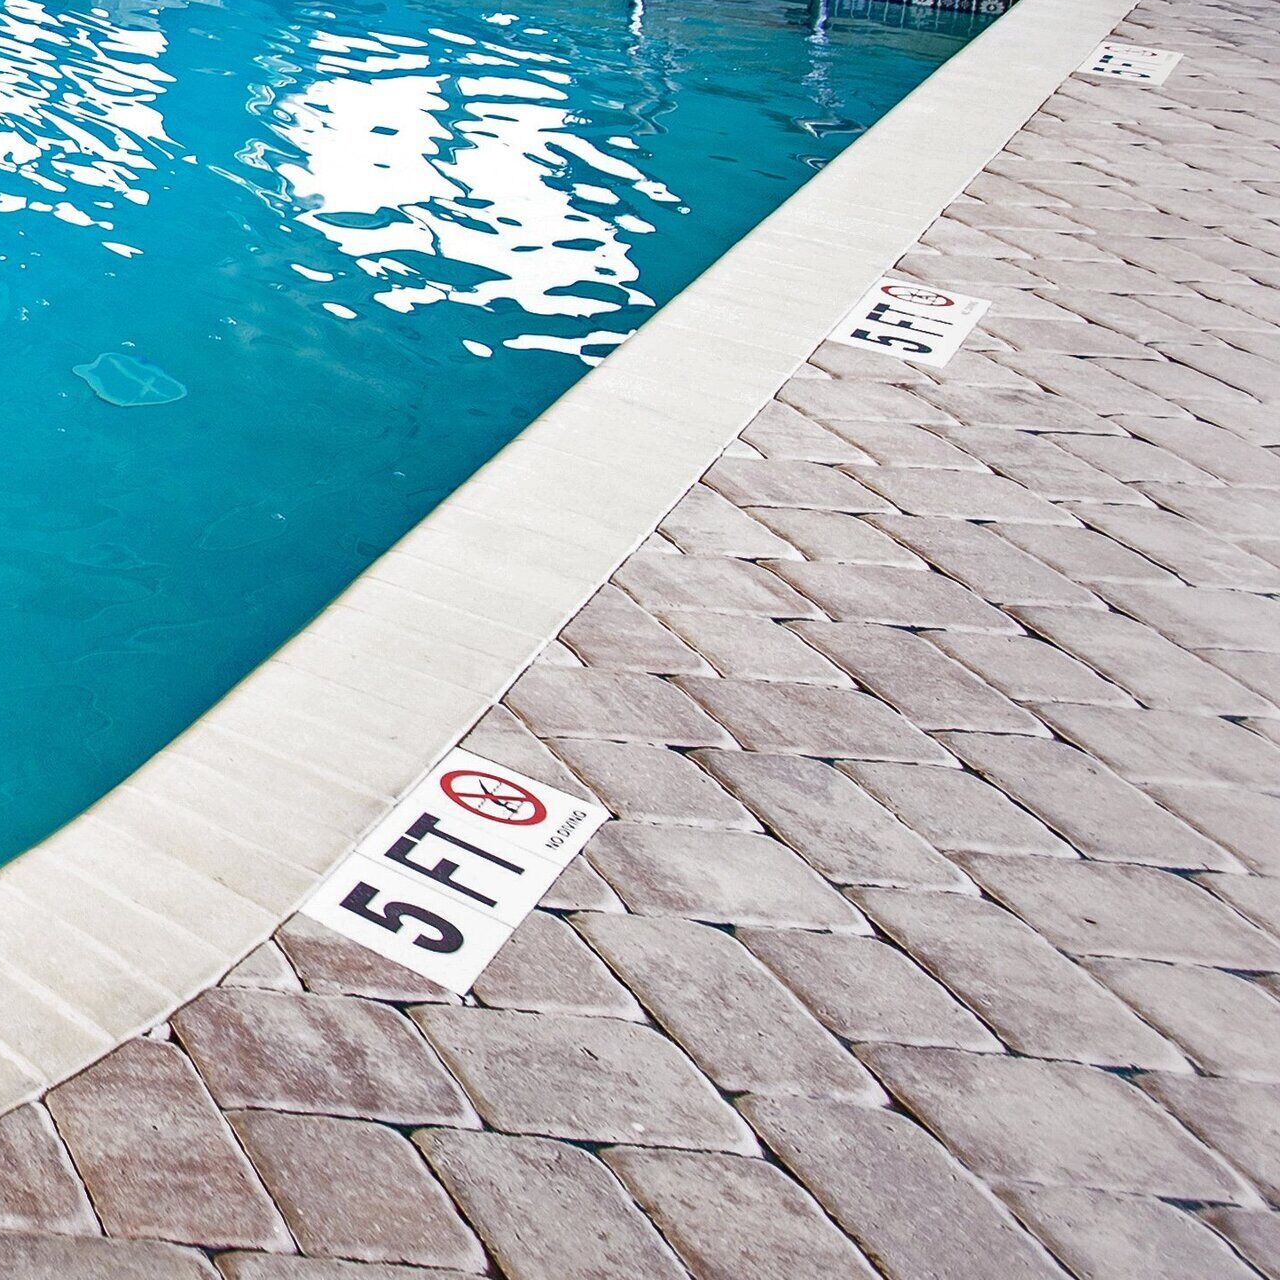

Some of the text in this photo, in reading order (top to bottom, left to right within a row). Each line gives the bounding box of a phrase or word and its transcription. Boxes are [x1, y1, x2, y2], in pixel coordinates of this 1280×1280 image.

[850, 302, 953, 354] 5 FT
[545, 809, 587, 851] NO DIVING
[339, 812, 526, 954] 5 FT
